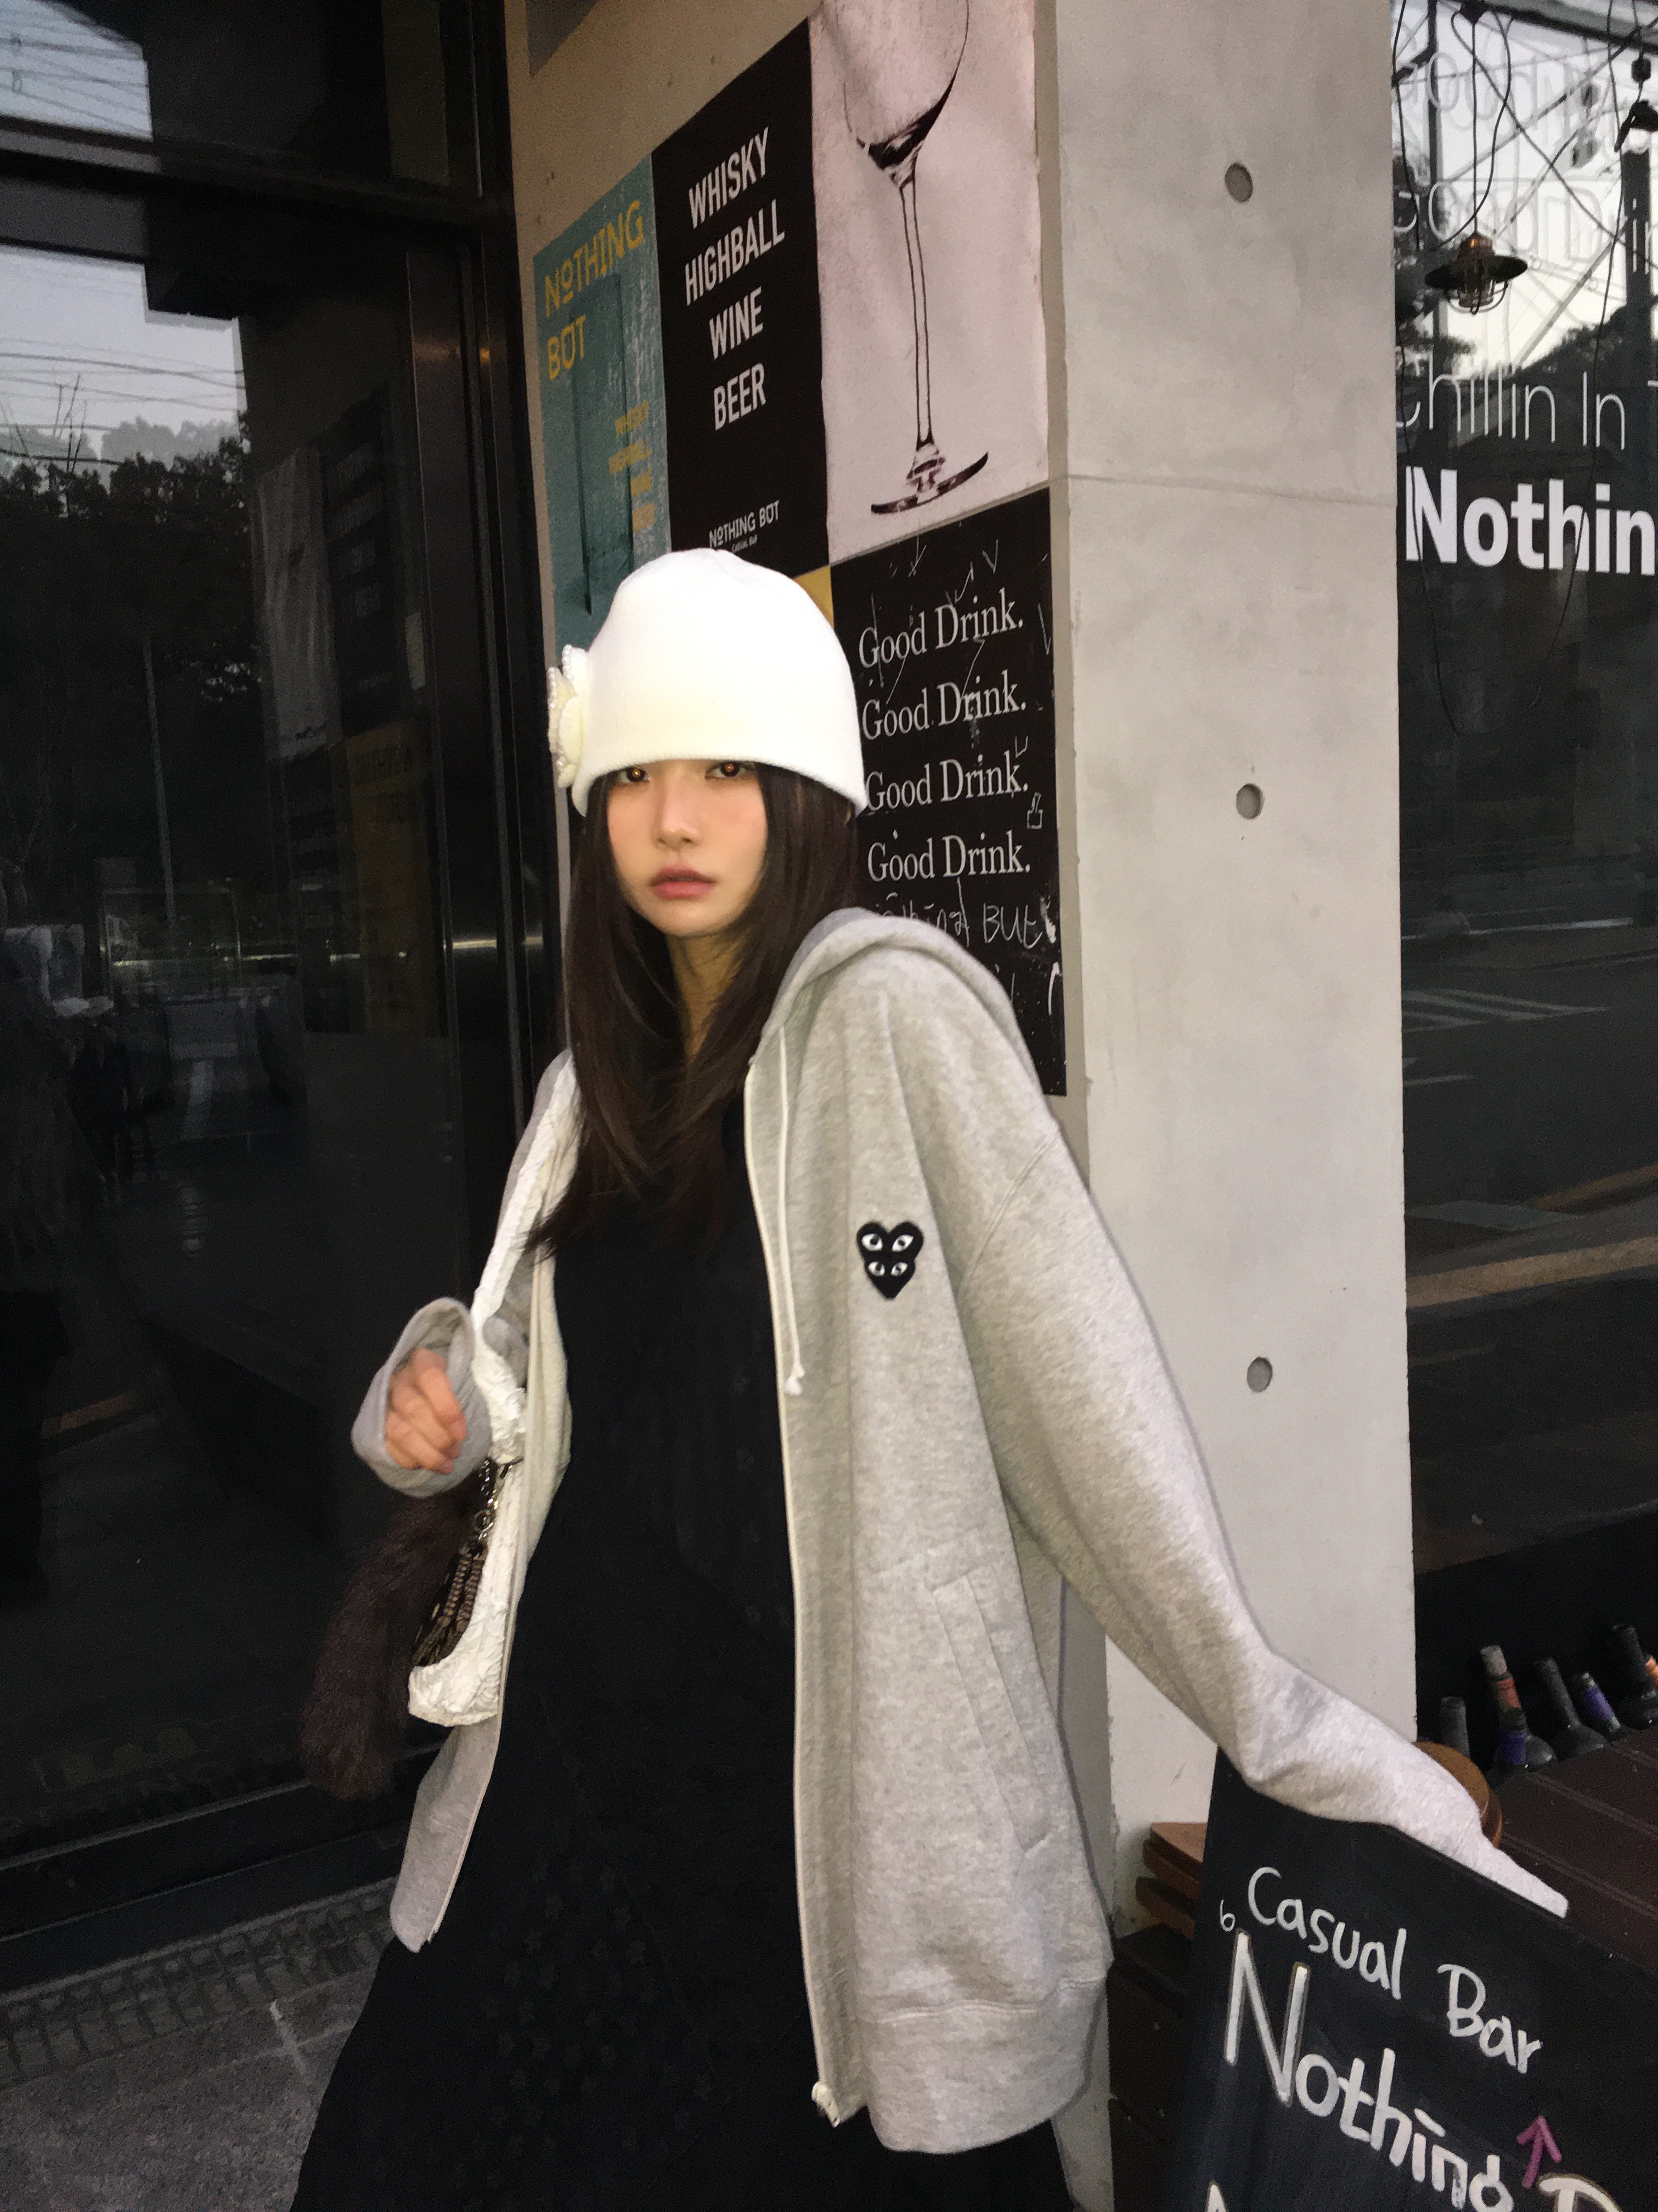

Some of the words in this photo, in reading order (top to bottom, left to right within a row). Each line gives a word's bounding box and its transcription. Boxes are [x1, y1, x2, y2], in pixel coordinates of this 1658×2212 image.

[688, 127, 769, 228] WHISKY
[545, 199, 644, 317] NOTHING
[685, 199, 785, 306] HIGHBALL
[548, 314, 586, 381] BOT
[709, 286, 764, 360] WINE
[713, 362, 766, 431] BEER
[709, 511, 756, 548] NOTHING
[759, 499, 780, 528] BOT
[1406, 465, 1655, 576] Nothin
[859, 611, 927, 668] Good
[935, 587, 1024, 650] Drink.
[862, 687, 930, 741] Good
[936, 668, 1026, 727] Drink.
[865, 763, 933, 811] Good
[939, 750, 1028, 803] Drink.
[867, 837, 935, 882] Good
[943, 830, 1030, 878] Drink.
[1248, 1866, 1407, 2000] Casual
[1436, 1963, 1543, 2074] Bar
